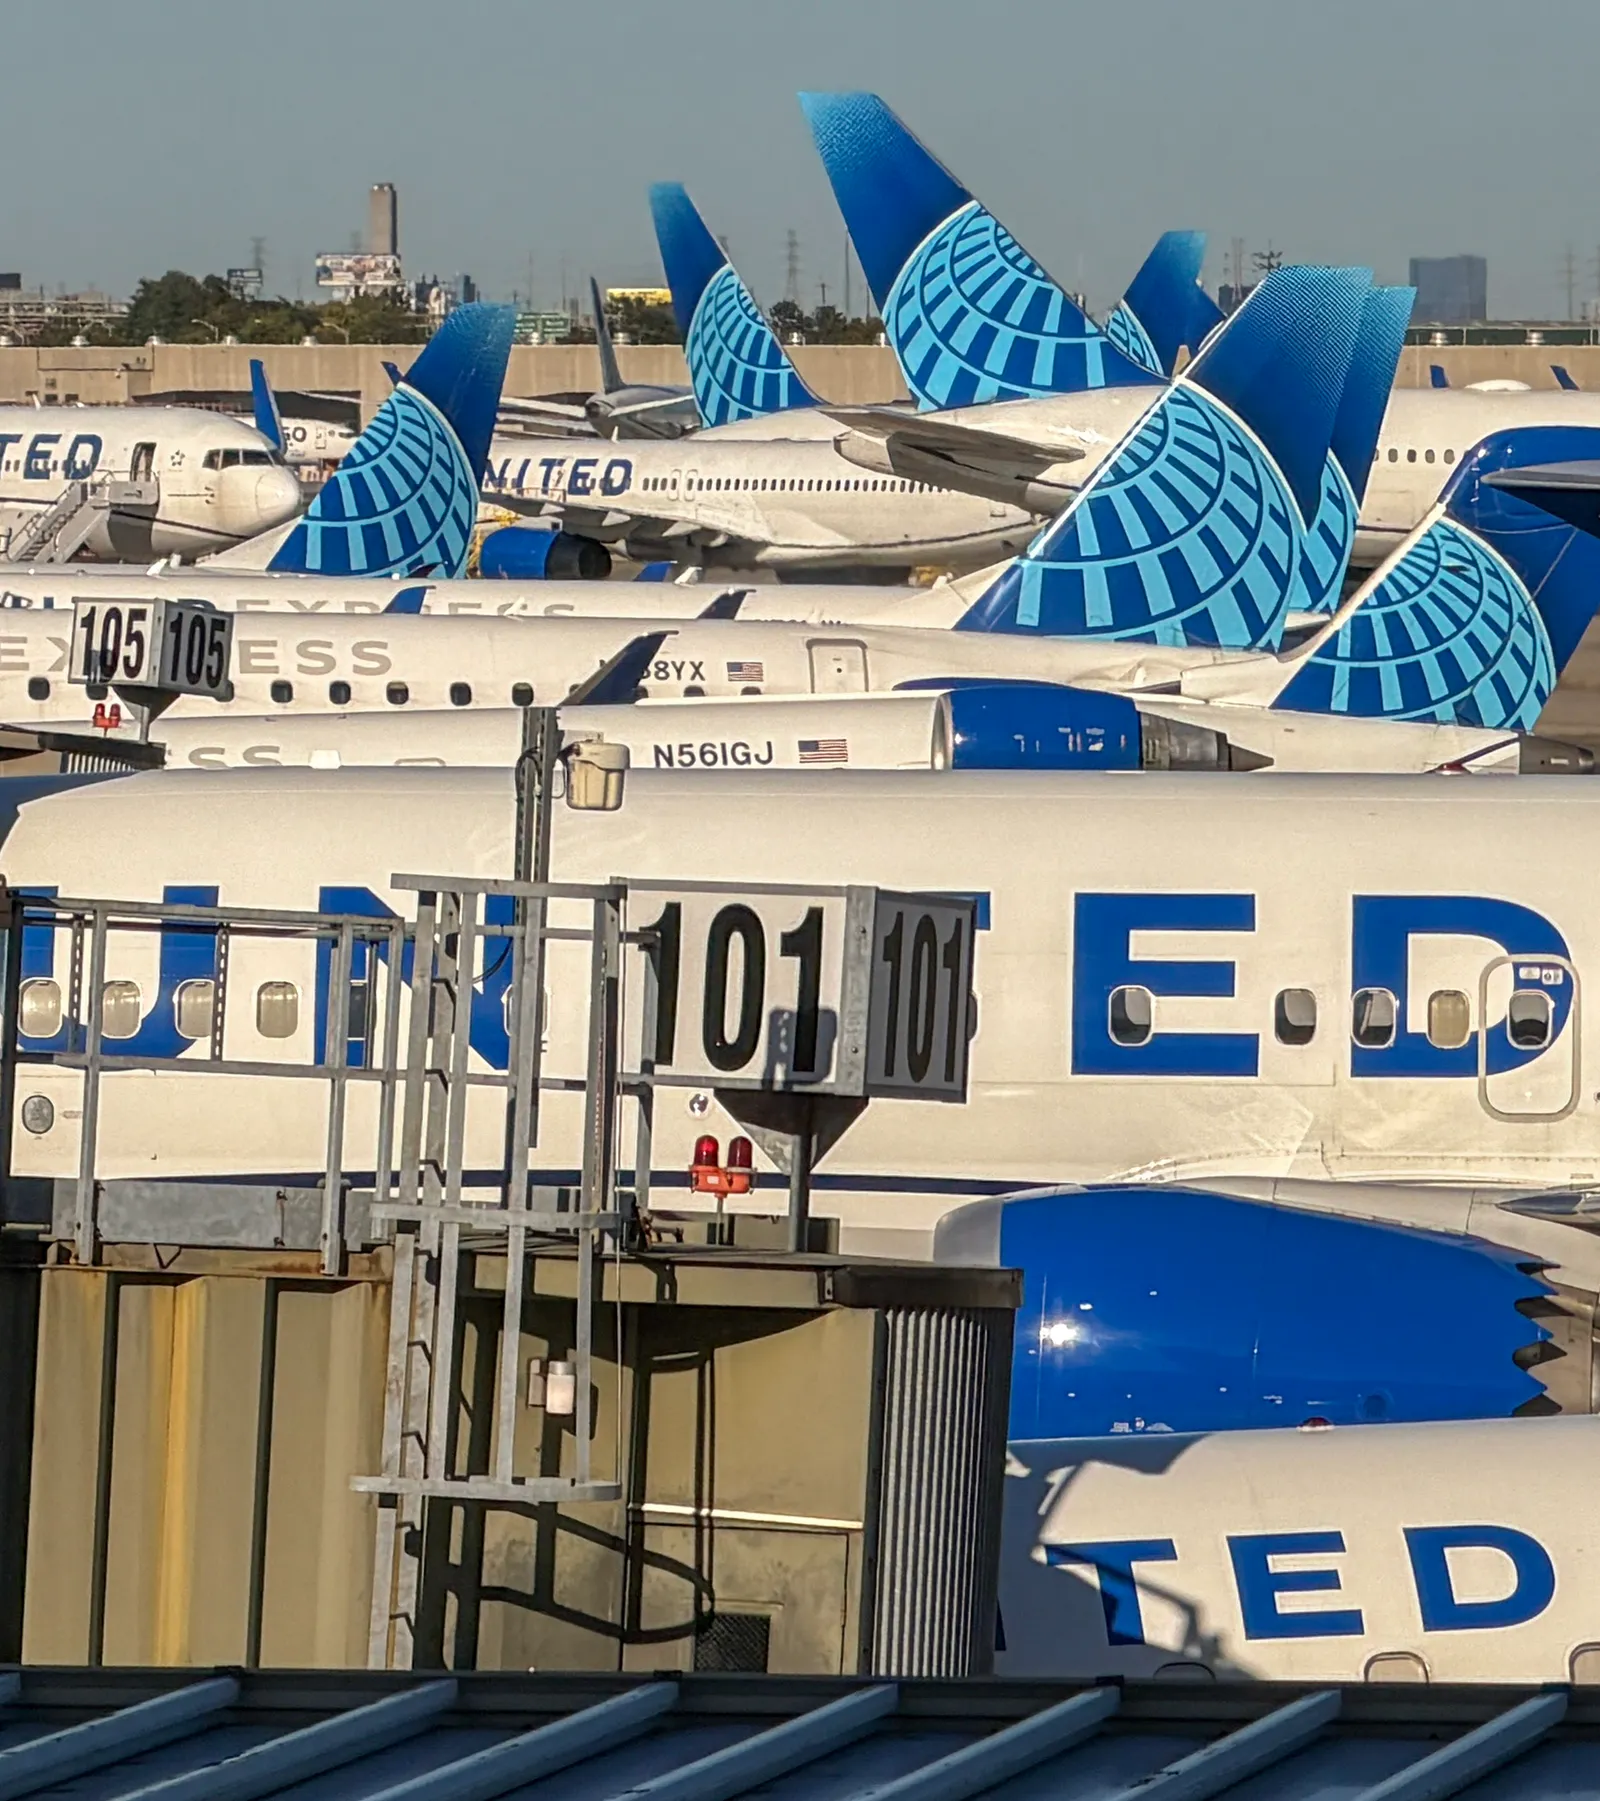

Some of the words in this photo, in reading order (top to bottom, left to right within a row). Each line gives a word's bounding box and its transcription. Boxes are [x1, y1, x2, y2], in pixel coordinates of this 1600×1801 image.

[80, 606, 147, 682] 105
[169, 612, 229, 689] 105
[639, 902, 824, 1072] 101
[882, 911, 964, 1083] 101
[995, 1523, 1556, 1651] TED
